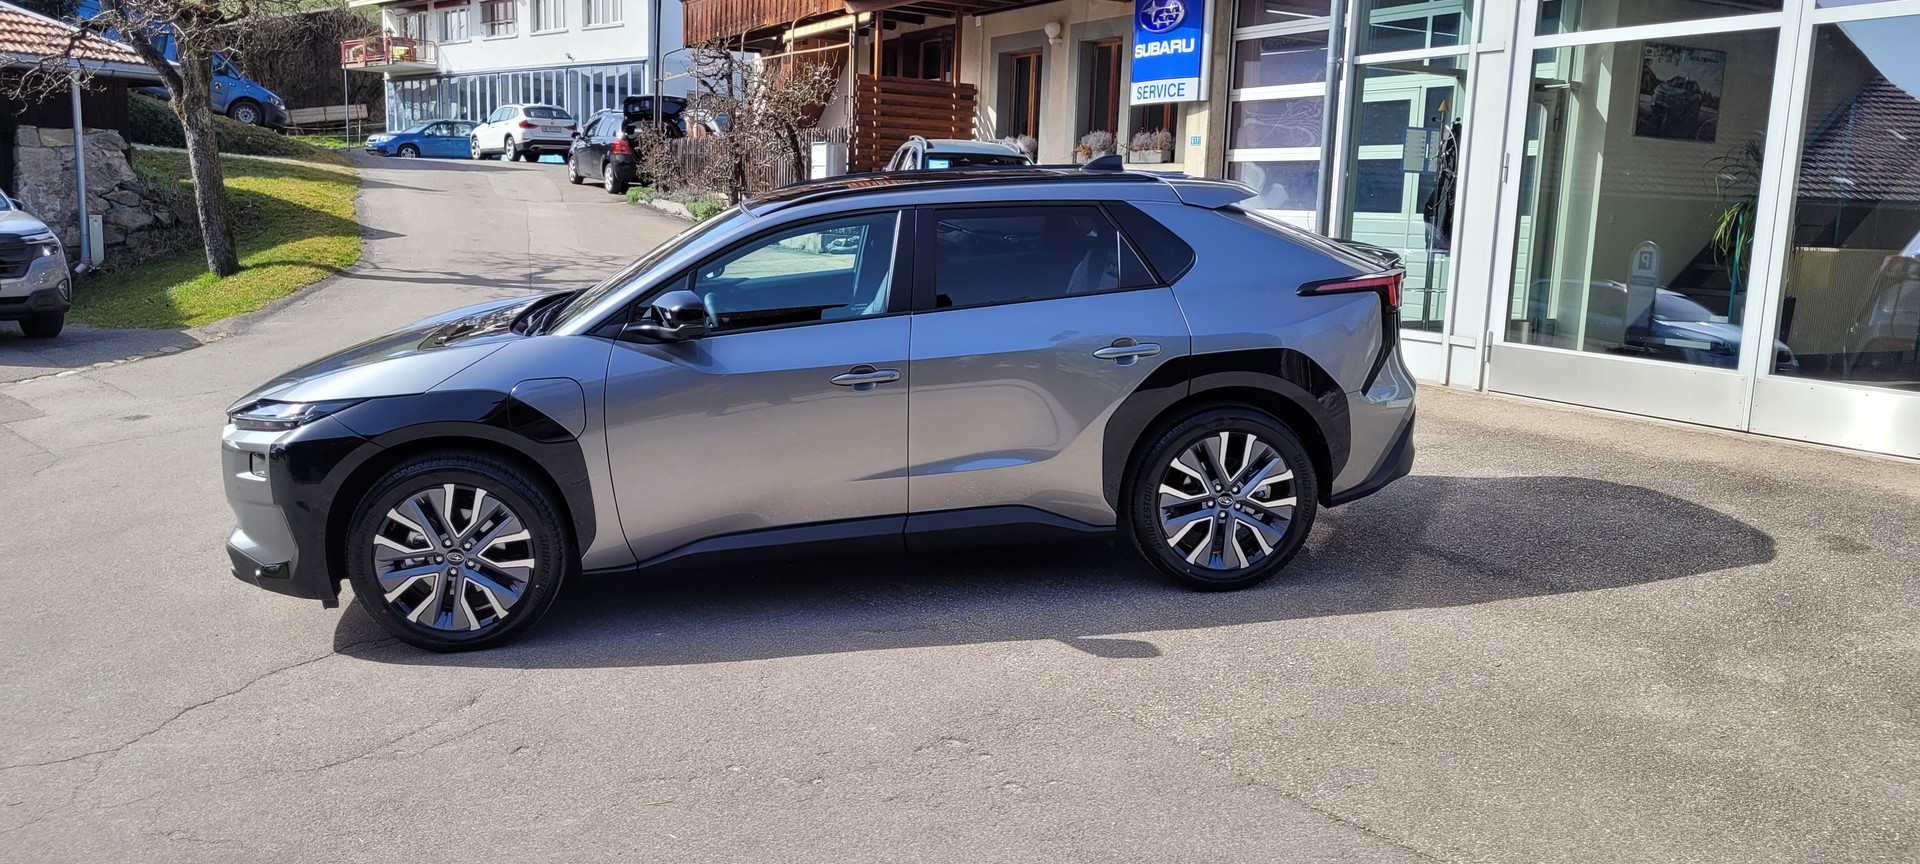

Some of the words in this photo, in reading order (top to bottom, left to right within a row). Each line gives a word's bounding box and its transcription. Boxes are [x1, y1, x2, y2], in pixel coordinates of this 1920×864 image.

[1135, 38, 1195, 58] SUBARU
[1137, 82, 1185, 100] SERVICE
[1294, 454, 1312, 524] BRIDGESTONE
[1143, 480, 1163, 551] BRIDGESTONE
